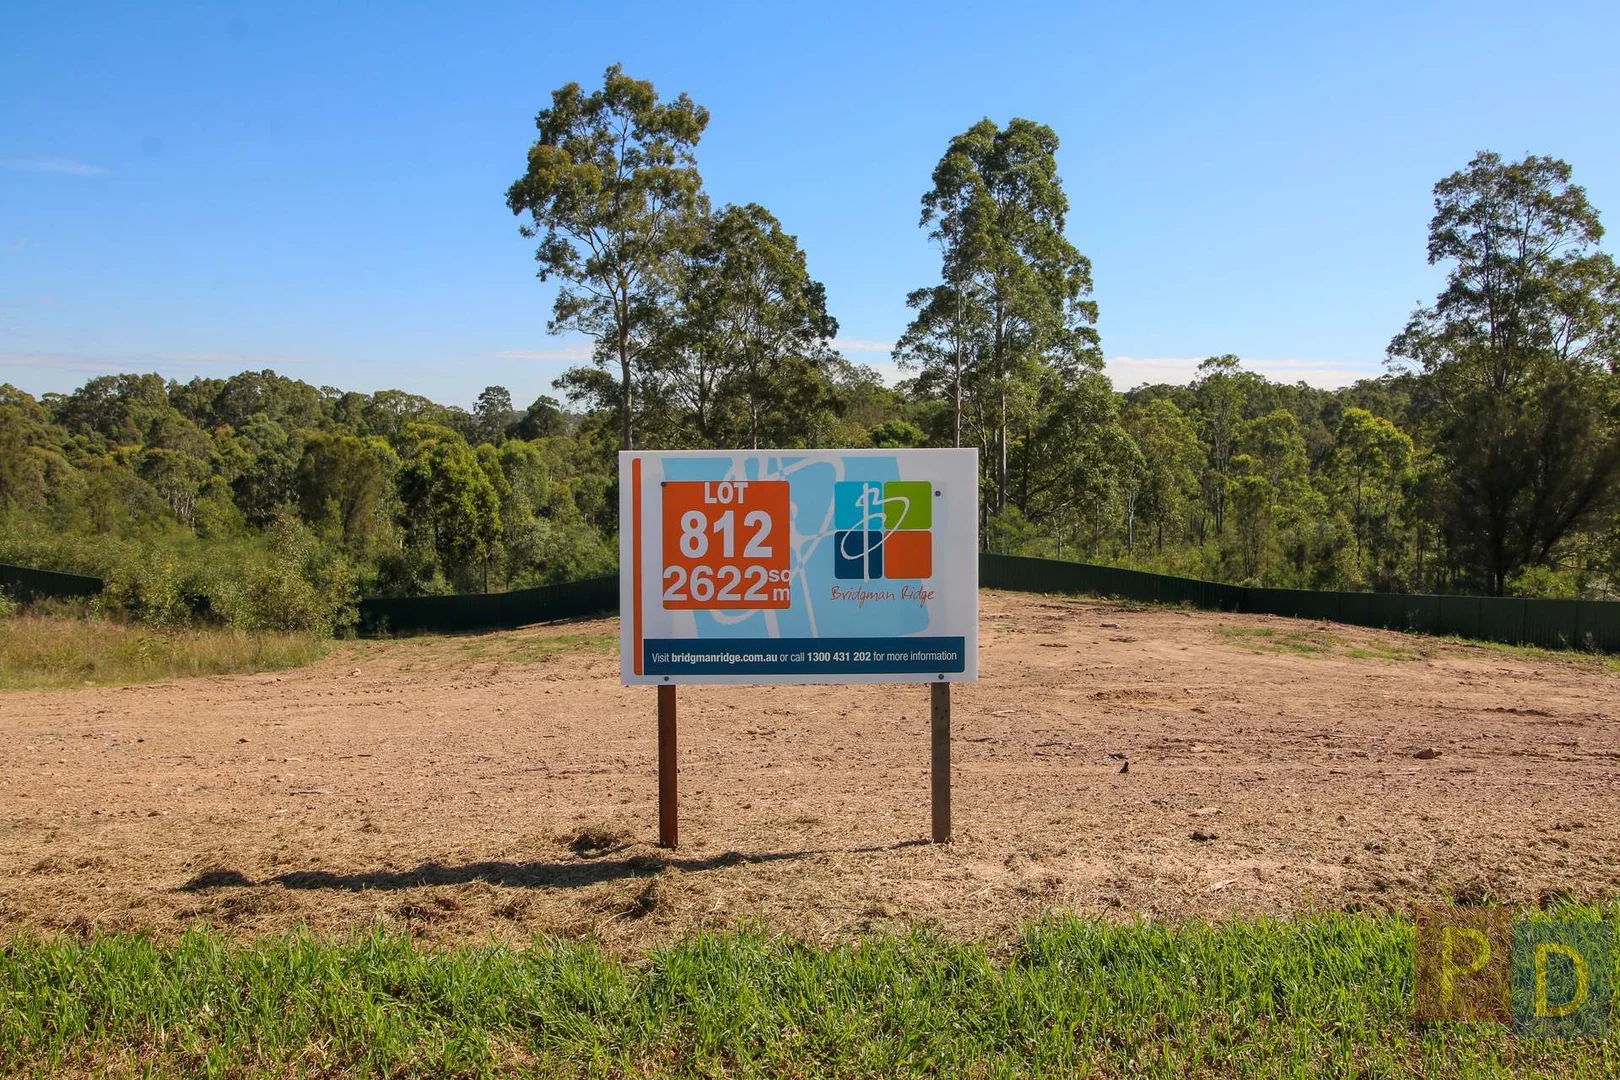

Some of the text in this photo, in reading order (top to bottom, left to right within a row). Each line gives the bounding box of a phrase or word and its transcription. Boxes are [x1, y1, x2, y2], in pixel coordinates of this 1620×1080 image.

[704, 482, 749, 504] LOT
[679, 510, 773, 558] 812
[662, 565, 769, 602] 2622
[830, 585, 936, 608] Bridgman Ridge
[651, 650, 957, 664] Visit bridgmanridge.com.au or call 1300 431 202 for more information
